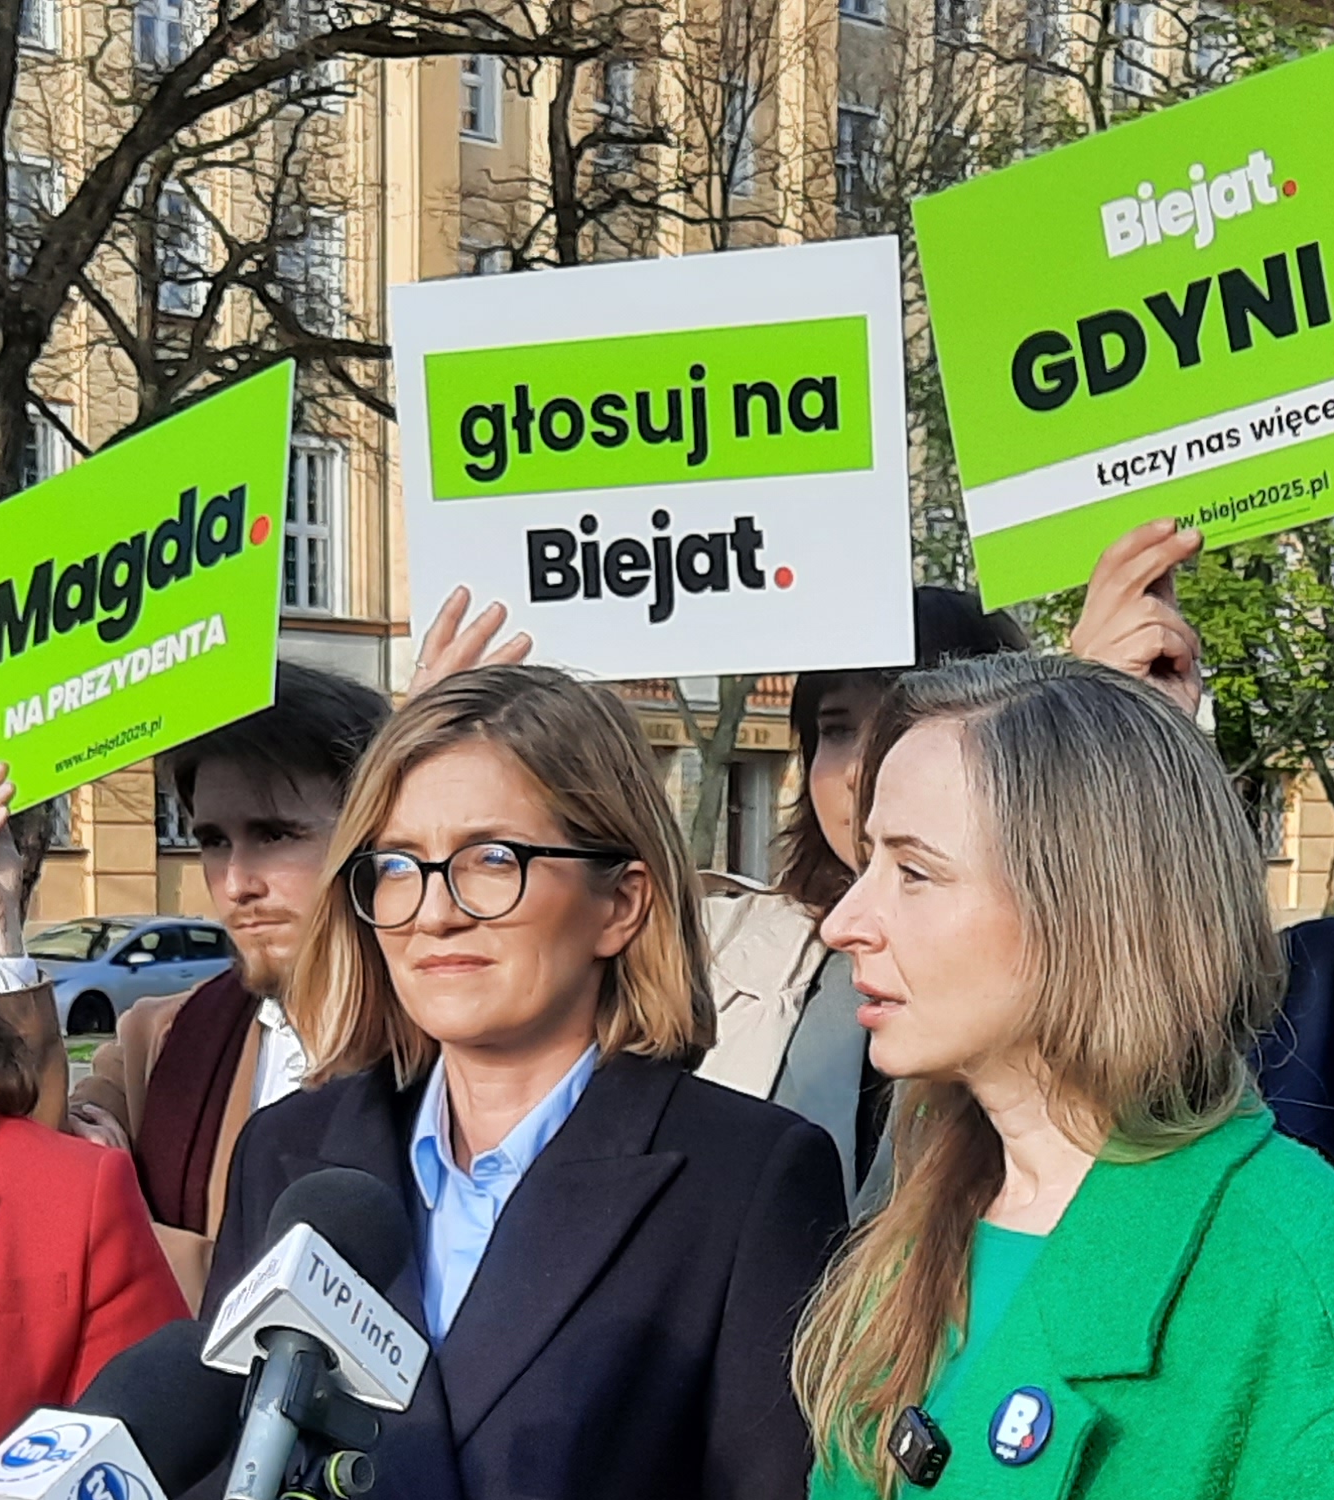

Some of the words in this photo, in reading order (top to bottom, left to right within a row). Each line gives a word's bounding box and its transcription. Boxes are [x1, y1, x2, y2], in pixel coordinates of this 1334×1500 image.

[1101, 150, 1298, 258] Biejat.
[460, 363, 709, 482] głosuj
[732, 375, 840, 439] na
[1097, 445, 1178, 486] Łączy
[1186, 428, 1241, 461] nas
[526, 508, 795, 625] Biejat.
[4, 695, 45, 740] NA
[47, 613, 227, 721] PREZYDENTA
[308, 1252, 353, 1308] TVP
